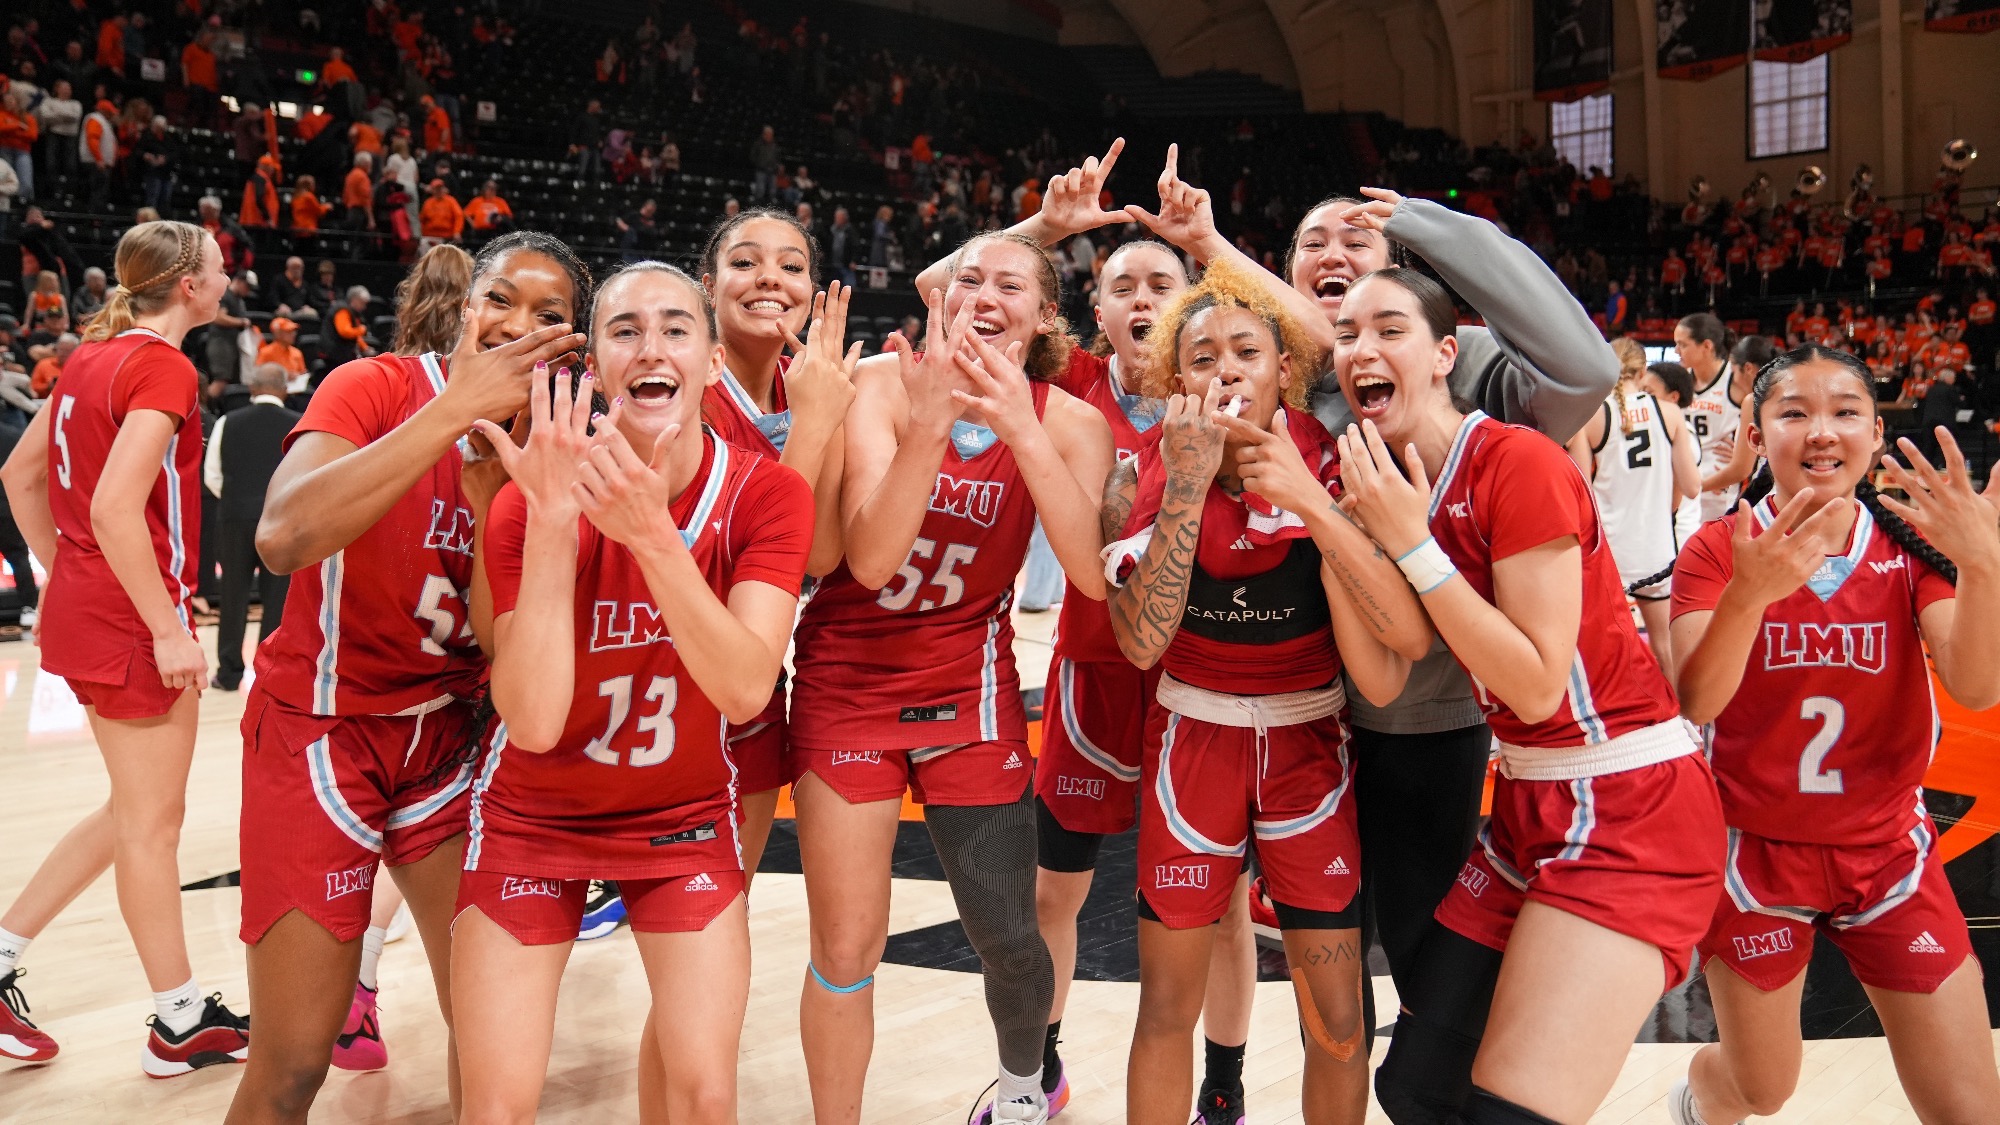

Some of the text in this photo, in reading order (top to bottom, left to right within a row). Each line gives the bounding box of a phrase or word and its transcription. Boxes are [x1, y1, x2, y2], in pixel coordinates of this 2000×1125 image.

[54, 393, 76, 490] 5
[956, 436, 983, 449] adidas
[1625, 429, 1652, 469] 2
[928, 472, 1005, 529] MU
[875, 536, 979, 612] 55
[1136, 519, 1200, 648] Jessica
[589, 599, 677, 653] LM
[1187, 605, 1296, 622] CATAPULT
[1764, 621, 1887, 675] LMU
[582, 673, 678, 768] 13
[1798, 695, 1845, 795] 2
[1002, 761, 1023, 770] adidas
[1056, 775, 1105, 800] LMU
[326, 863, 374, 902] LMU
[501, 876, 561, 901] LMU
[684, 883, 719, 892] adidas
[1155, 863, 1210, 890] LMU
[1324, 868, 1351, 876] adidas
[1457, 862, 1490, 898] MU
[1732, 926, 1794, 962] LMU
[1907, 944, 1946, 954] adidas
